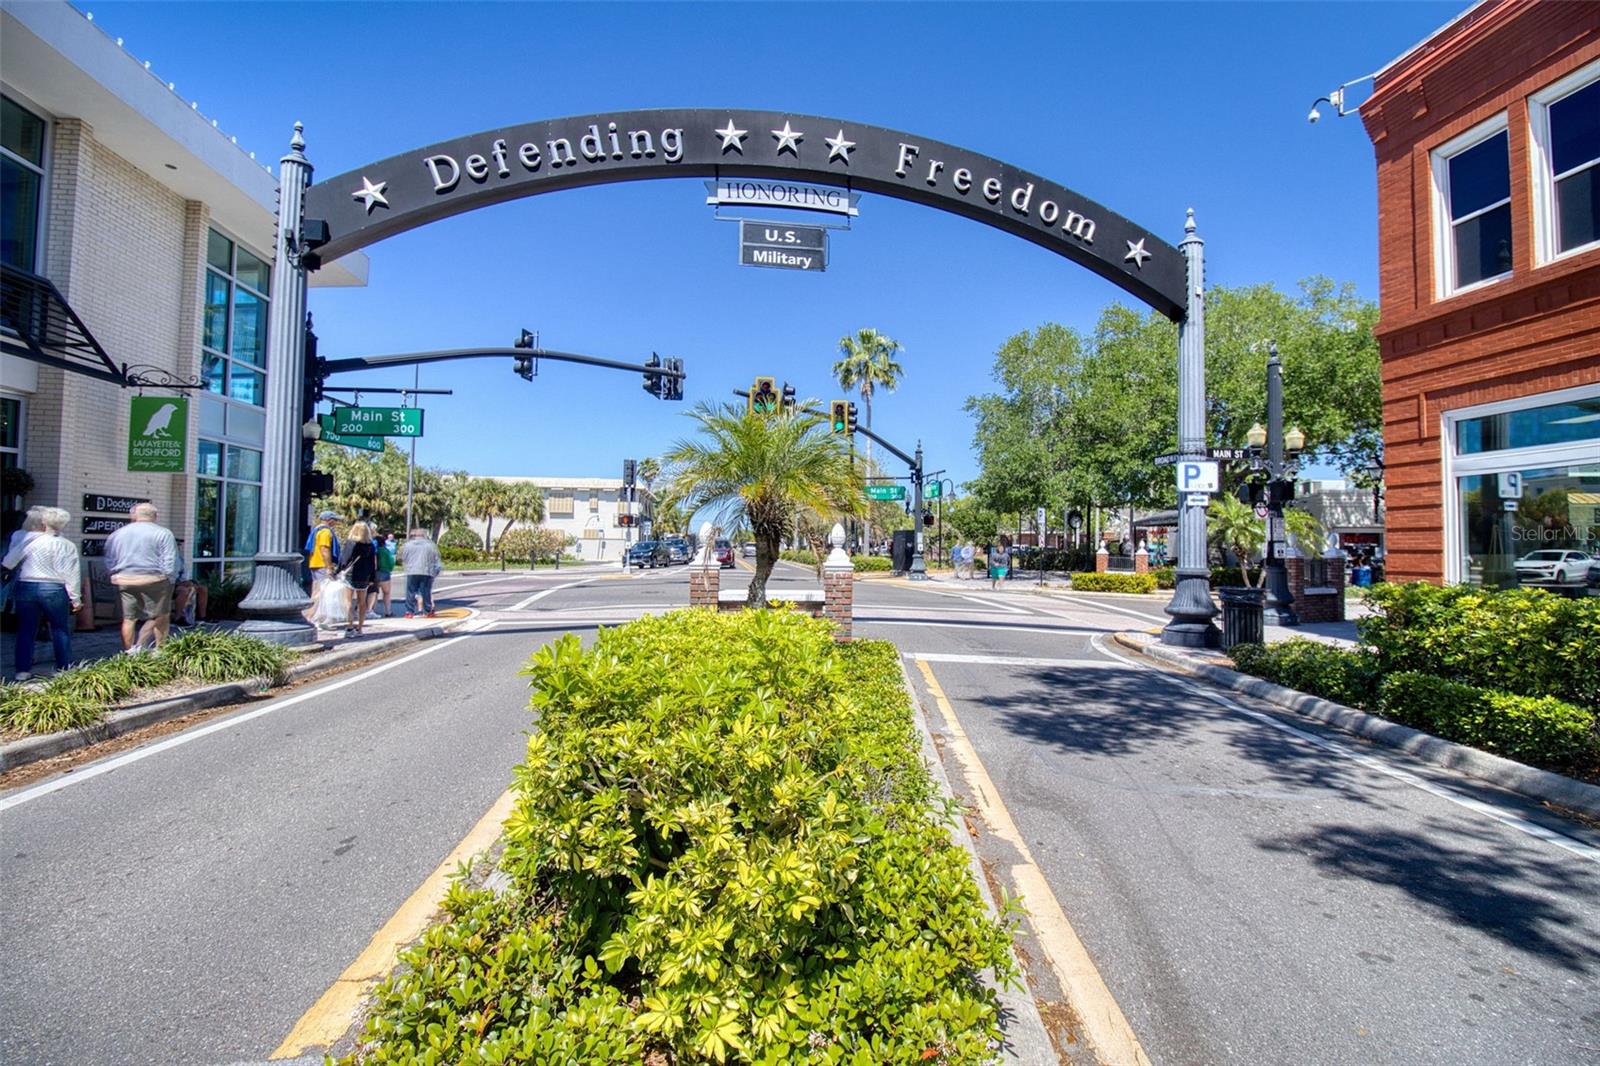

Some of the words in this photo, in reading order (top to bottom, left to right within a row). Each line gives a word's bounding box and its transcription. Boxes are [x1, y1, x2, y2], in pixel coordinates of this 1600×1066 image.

[424, 122, 684, 192] Defending
[895, 143, 1097, 243] Freedom
[725, 182, 842, 208] HONORING
[765, 229, 802, 243] U.S.
[753, 250, 813, 269] Military
[351, 410, 383, 422] Main
[391, 411, 406, 422] St
[341, 423, 363, 432] 200
[393, 424, 415, 434] 300
[132, 448, 181, 457] RUSHFORD
[1213, 450, 1231, 458] MAIN
[1234, 450, 1244, 458] ST
[1184, 464, 1201, 488] P
